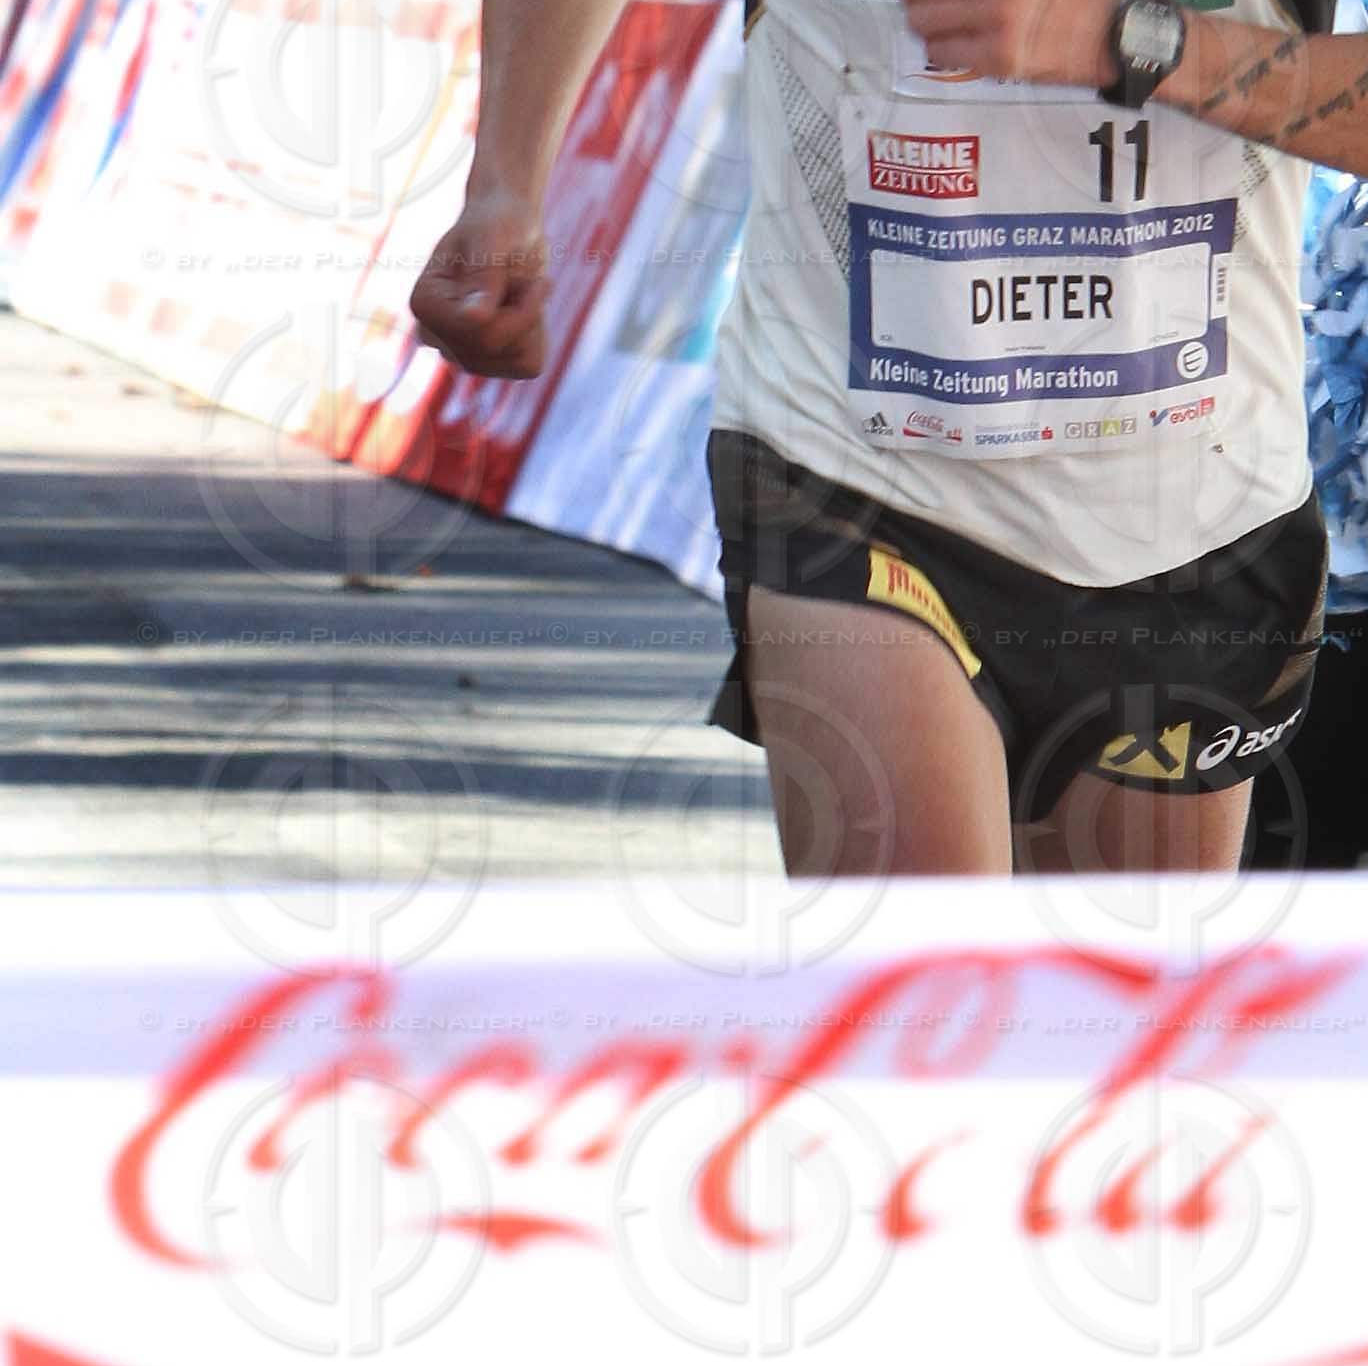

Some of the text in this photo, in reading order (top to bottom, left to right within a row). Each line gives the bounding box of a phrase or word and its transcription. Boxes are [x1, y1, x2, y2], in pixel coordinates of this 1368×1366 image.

[872, 135, 976, 169] KLEINE
[1088, 120, 1150, 203] 11
[874, 168, 976, 195] ZEITUNG
[867, 213, 1215, 250] KLEINE ZEITUNG GRAZ MARATHON 2012
[971, 274, 1114, 325] DIETER
[869, 357, 1119, 397] Kleine Zeitung Marathon
[975, 431, 1041, 447] SPARKASSE
